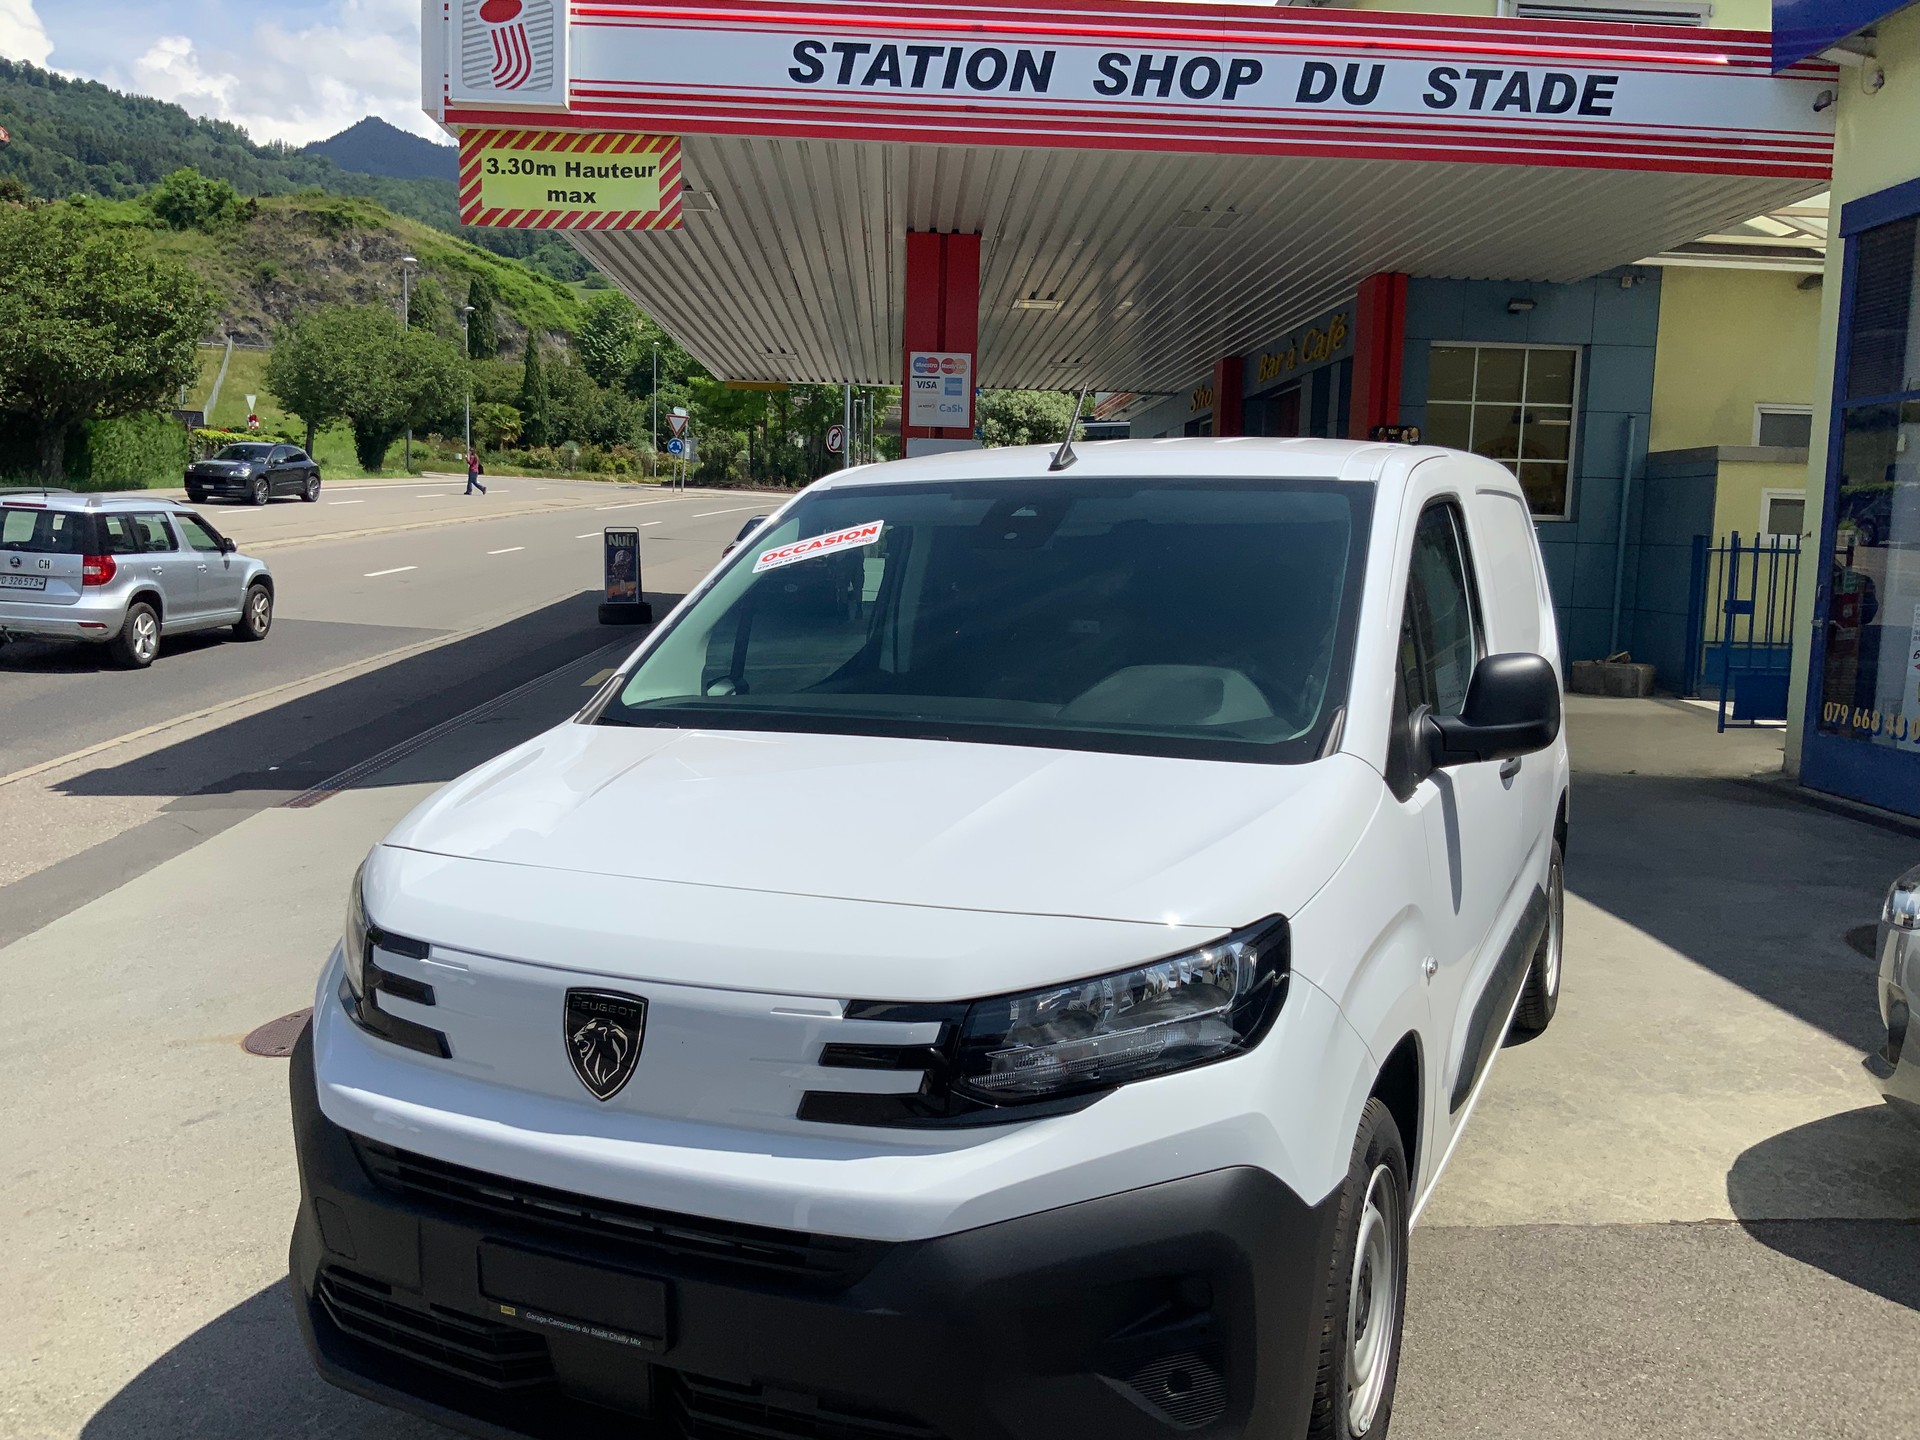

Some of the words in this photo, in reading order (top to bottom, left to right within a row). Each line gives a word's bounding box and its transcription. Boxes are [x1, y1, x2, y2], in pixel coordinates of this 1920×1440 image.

[788, 39, 1057, 93] STATION
[1092, 52, 1263, 101] SHOP
[1295, 61, 1386, 106] DU
[1422, 66, 1619, 117] STADE
[486, 157, 557, 177] 3.30m
[565, 161, 657, 179] Hauteur
[547, 189, 597, 204] max
[1259, 352, 1284, 384] Bar
[1287, 336, 1298, 371] à
[1302, 312, 1347, 363] Café
[916, 380, 938, 389] VISA
[1190, 384, 1214, 413] Sho
[939, 403, 963, 413] CaSh
[761, 526, 878, 562] OCCASION
[38, 559, 50, 569] CH
[9, 575, 39, 587] 326573
[1823, 701, 1849, 725] 079
[1852, 707, 1881, 733] 668
[571, 1000, 637, 1017] PEUGEOT
[581, 1325, 590, 1334] du
[590, 1327, 608, 1338] Stade
